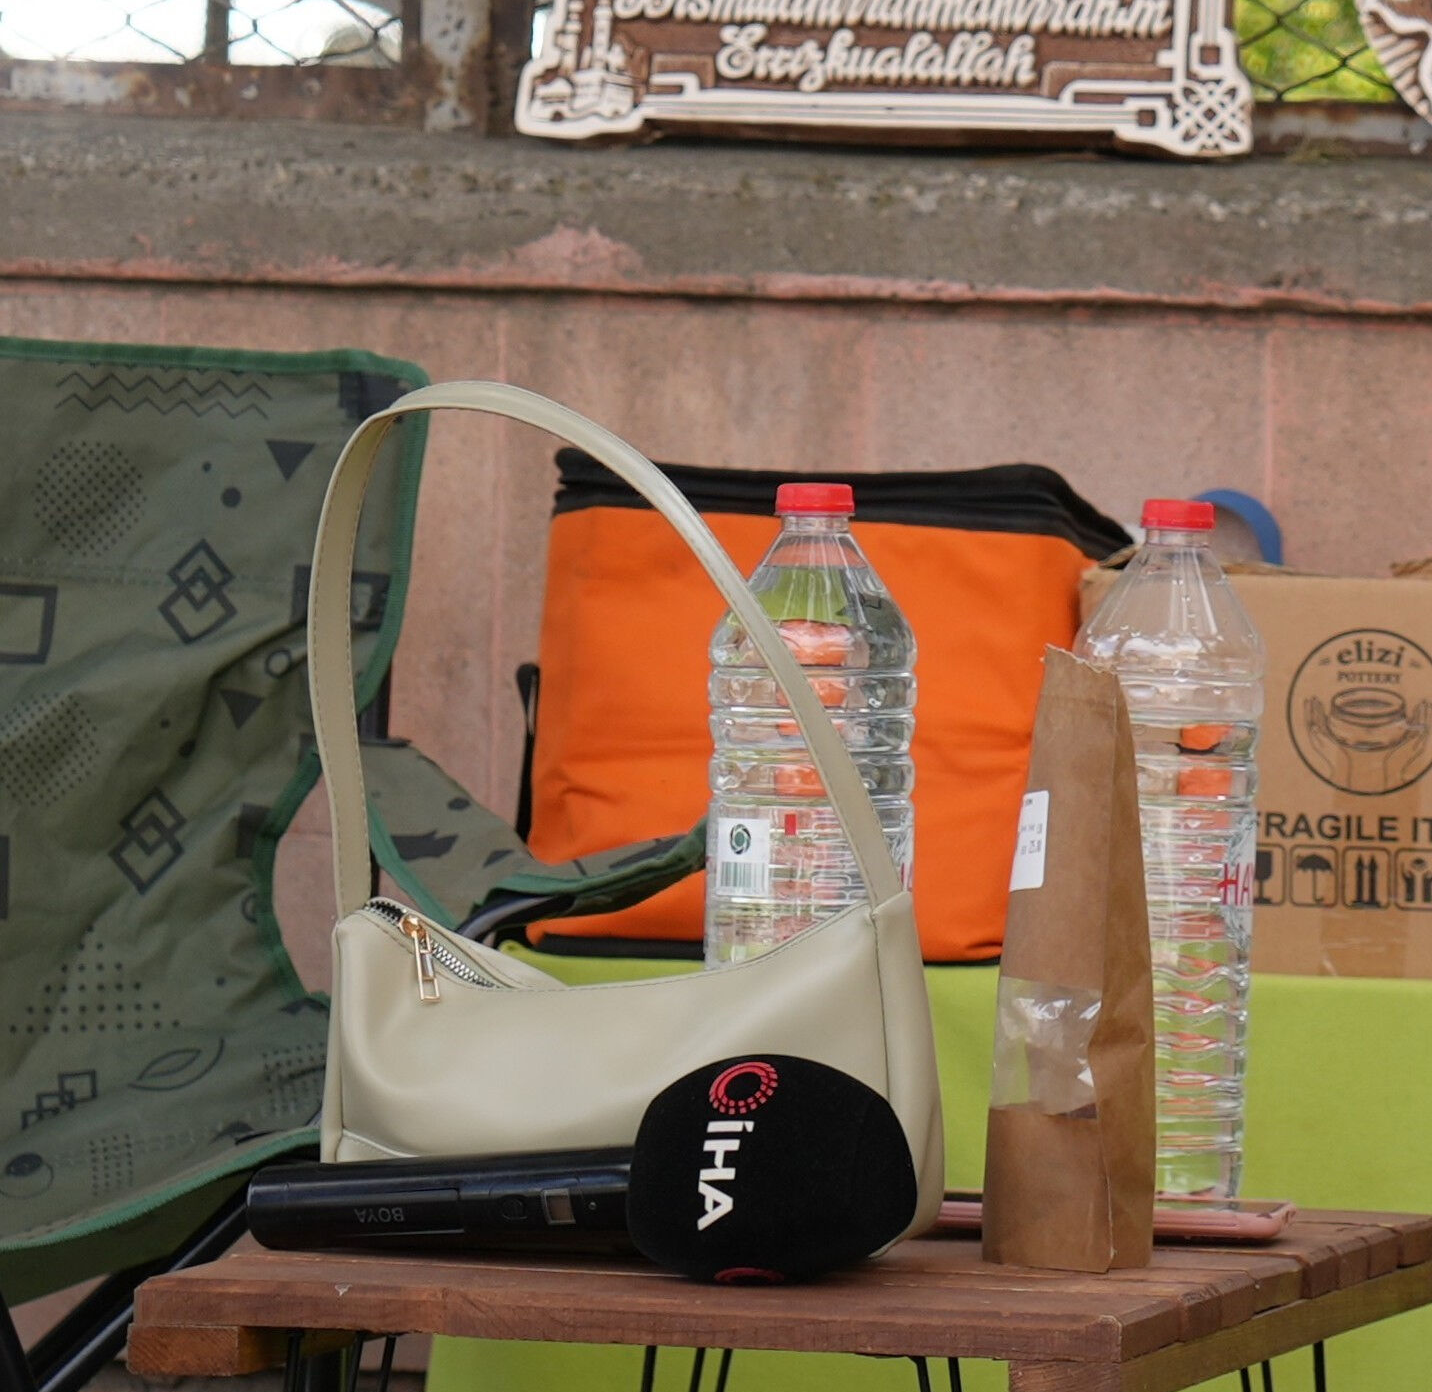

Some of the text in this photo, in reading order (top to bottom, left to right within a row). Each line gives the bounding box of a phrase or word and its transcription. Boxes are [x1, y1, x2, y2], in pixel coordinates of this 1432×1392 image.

[1336, 639, 1406, 668] elizi
[1336, 670, 1403, 684] POTTERY
[1257, 810, 1399, 842] RAGILE
[353, 1207, 405, 1224] BOYA
